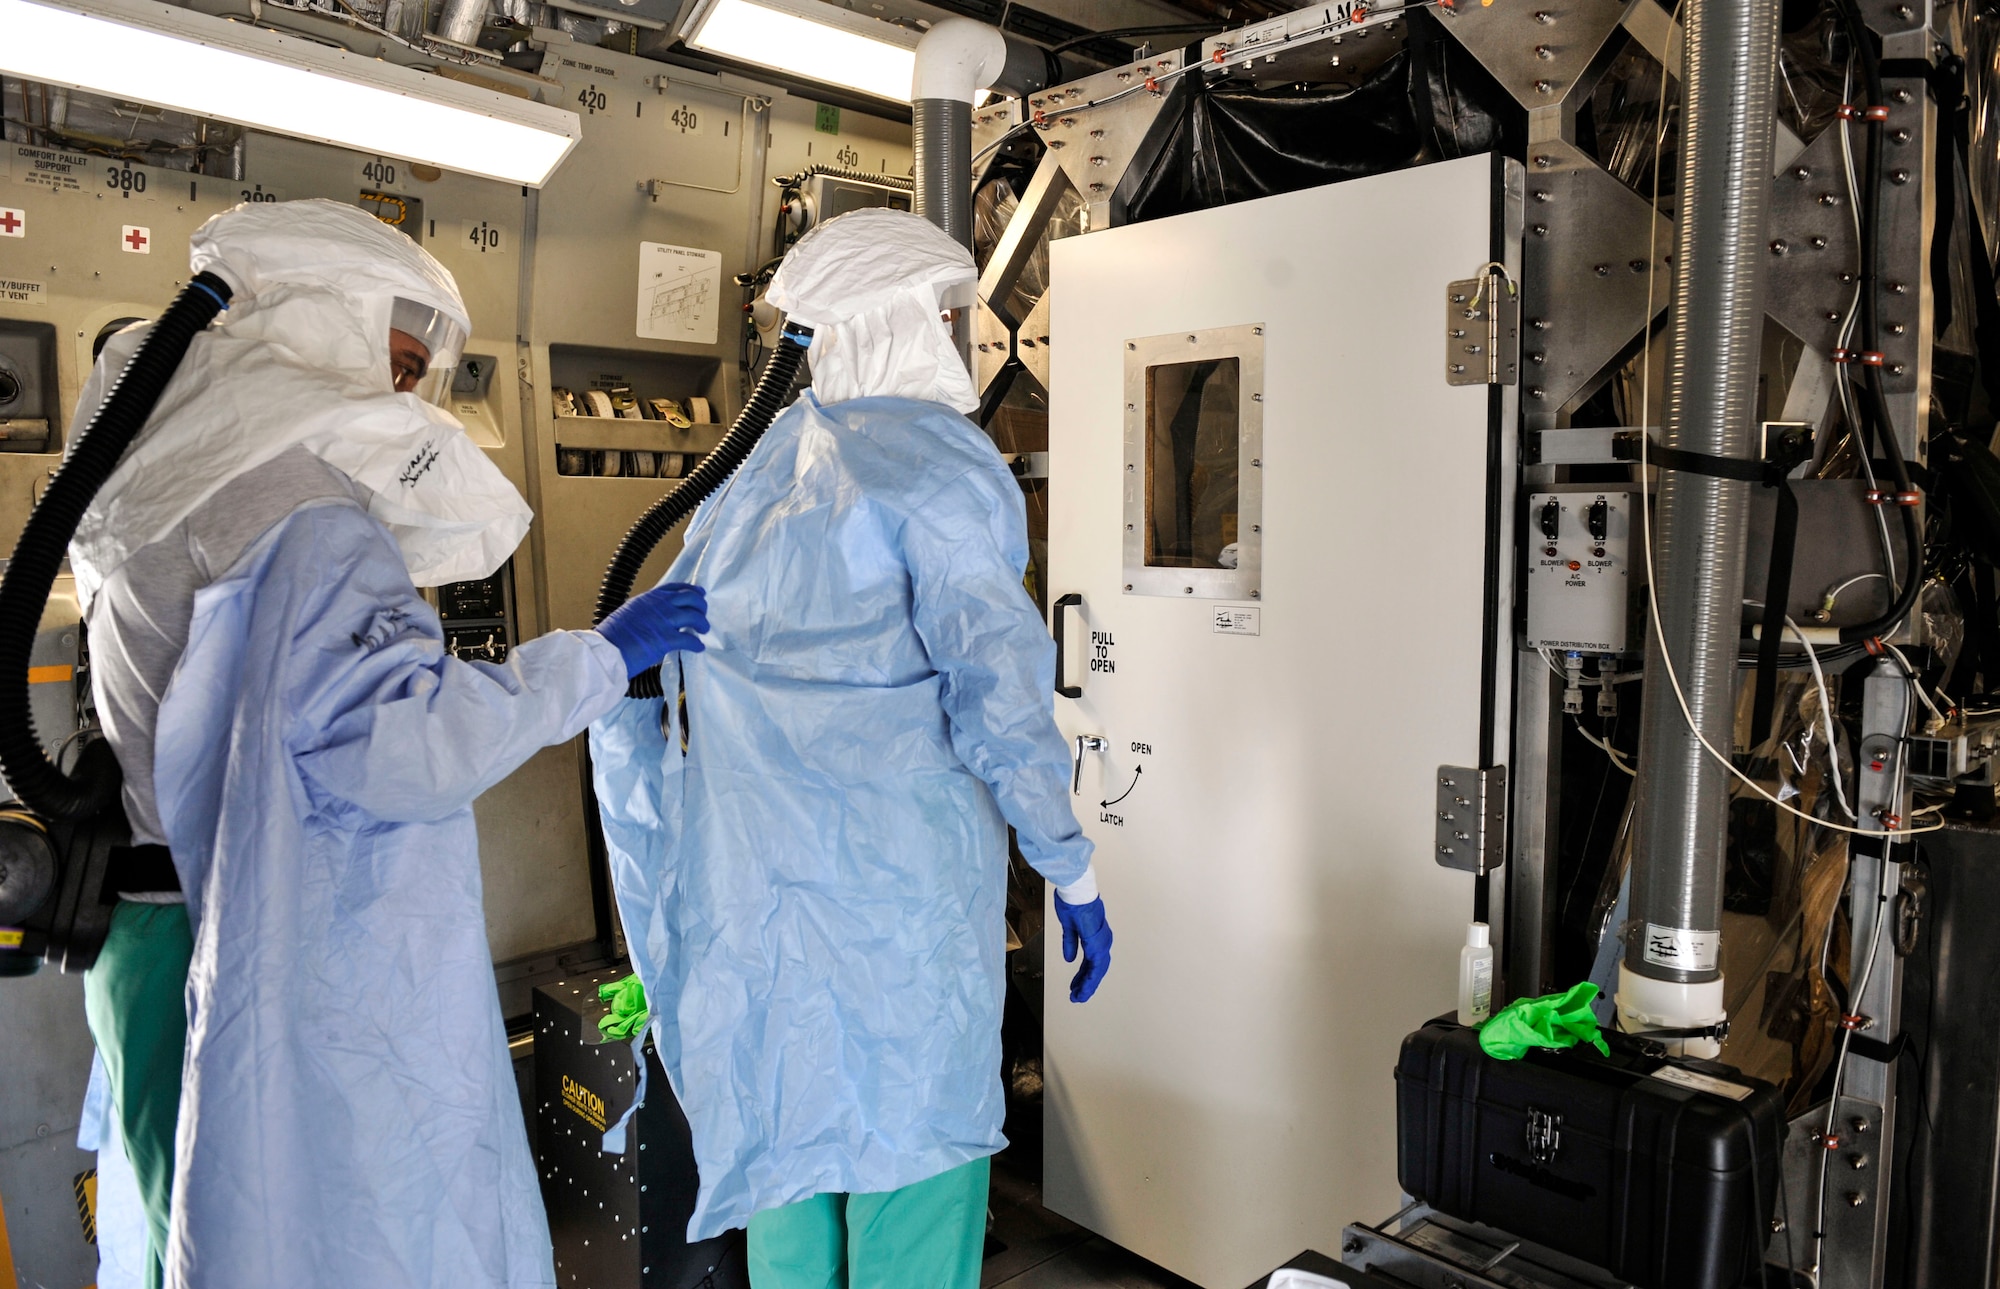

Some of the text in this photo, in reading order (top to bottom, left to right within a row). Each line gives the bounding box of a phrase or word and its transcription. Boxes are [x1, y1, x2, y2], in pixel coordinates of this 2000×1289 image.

[562, 58, 615, 76] ZONE TEMP SENSOR
[578, 89, 606, 110] 420
[671, 109, 697, 129] 430
[18, 147, 88, 166] COMFORT PALLET
[836, 149, 858, 167] 450
[34, 159, 72, 173] SUPPORT
[362, 162, 395, 185] 400
[107, 167, 146, 193] 380
[469, 227, 499, 248] 410
[0, 280, 40, 292] Y/BUFFET
[8, 291, 29, 301] VENT
[1092, 631, 1115, 646] PULL
[1560, 641, 1597, 649] DISTRIBUTION
[1096, 645, 1108, 659] TO
[1090, 658, 1115, 674] OPEN
[1131, 741, 1152, 755] OPEN
[1100, 811, 1124, 827] LATCH
[562, 1074, 605, 1118] CAUTION
